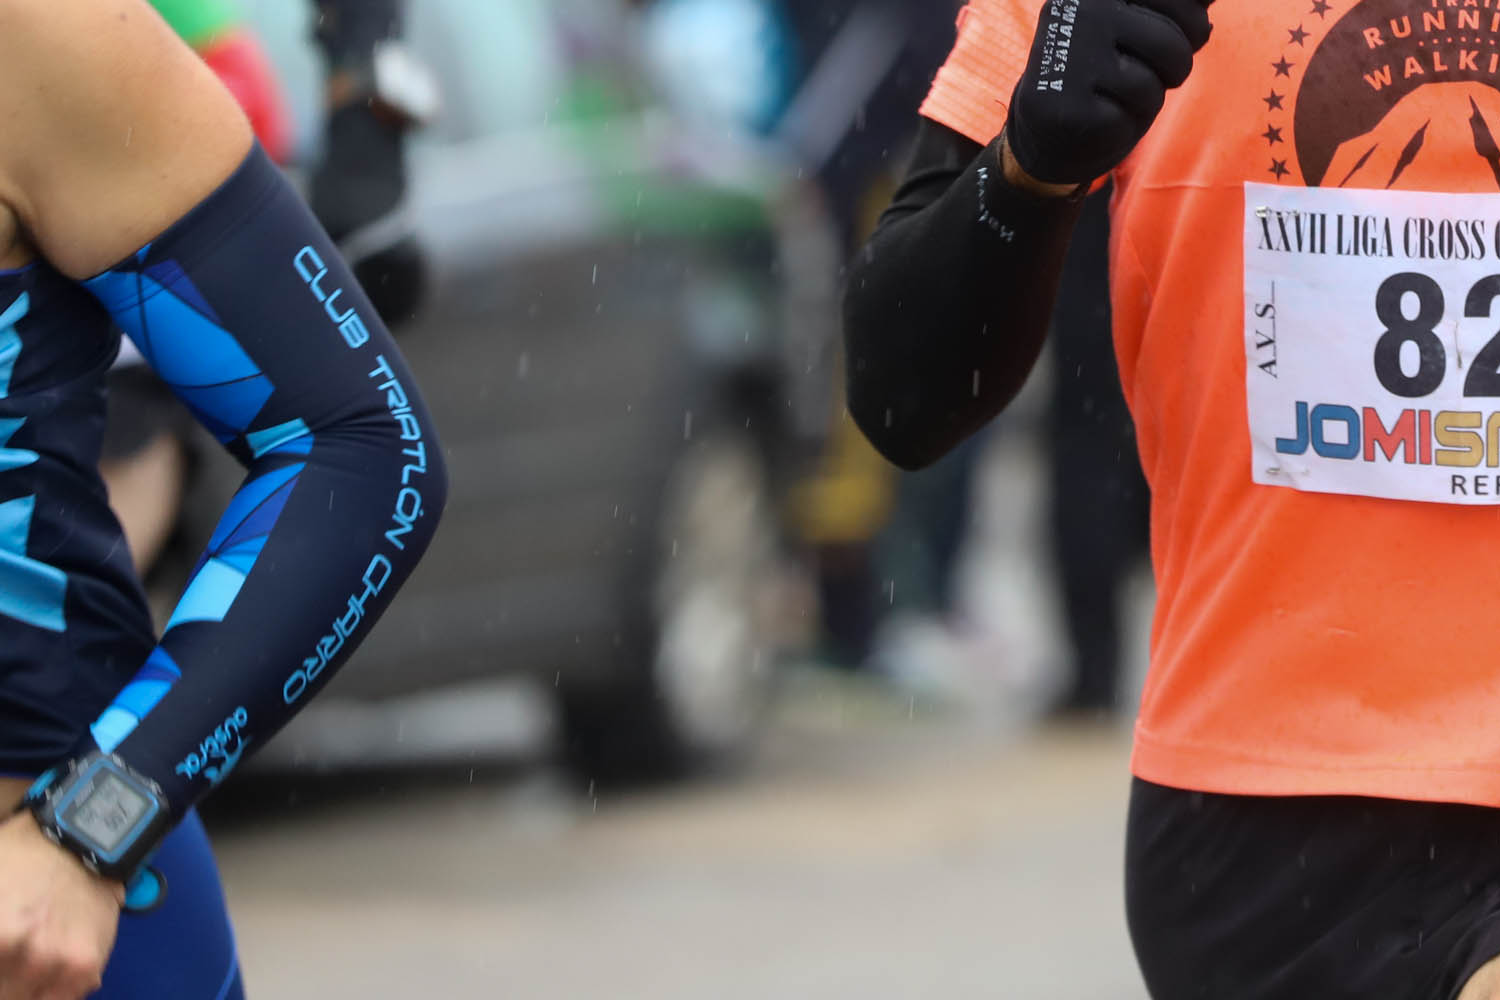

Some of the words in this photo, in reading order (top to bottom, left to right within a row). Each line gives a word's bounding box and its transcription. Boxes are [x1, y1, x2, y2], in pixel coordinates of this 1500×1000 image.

[1050, 79, 1063, 91] A
[1335, 214, 1394, 258] LIGA
[1403, 216, 1486, 260] CROSS
[293, 245, 370, 348] CLUB
[368, 354, 427, 550] TRIATLÓN
[283, 554, 392, 704] CHARRO
